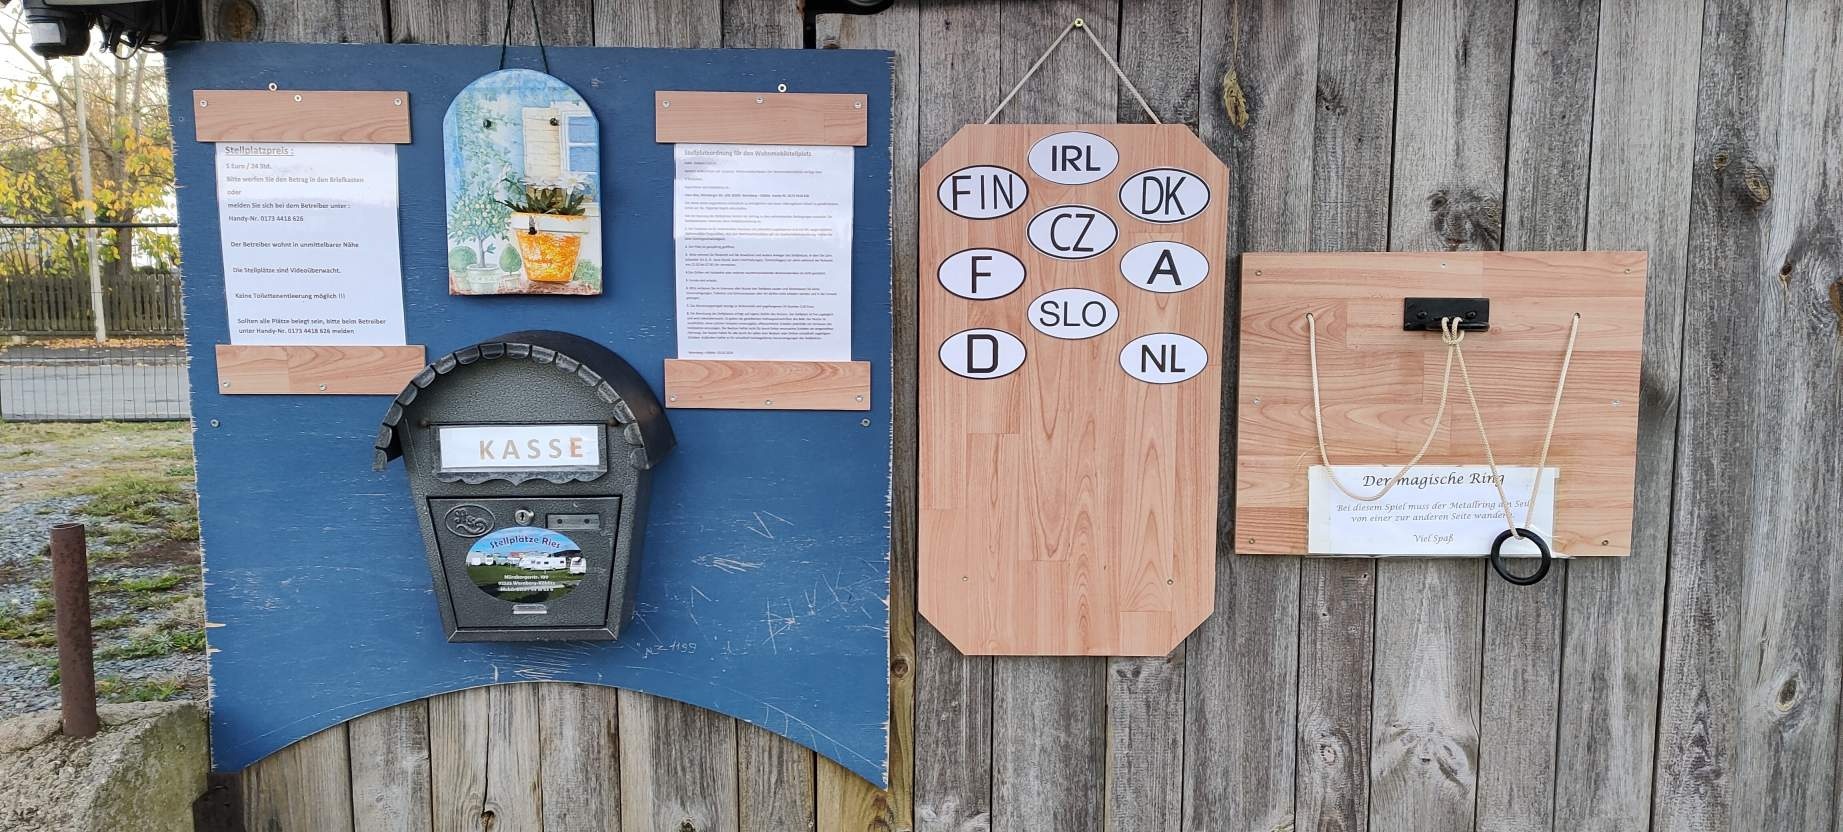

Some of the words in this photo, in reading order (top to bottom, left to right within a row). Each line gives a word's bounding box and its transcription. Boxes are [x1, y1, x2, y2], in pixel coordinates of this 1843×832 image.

[225, 146, 288, 156] Stellplatzpreis
[1051, 145, 1100, 172] IRL
[952, 174, 1014, 210] FIN
[1141, 176, 1186, 215] DK
[1050, 213, 1096, 252] CZ
[971, 256, 992, 294] F
[1146, 249, 1182, 286] A
[1039, 300, 1106, 328] SLO
[967, 334, 998, 374] D
[1141, 344, 1186, 373] NL
[479, 437, 584, 460] KASSE
[1362, 475, 1392, 487] Der
[1396, 472, 1464, 489] magische
[1384, 503, 1406, 513] Spiel
[1431, 502, 1447, 510] der
[1449, 501, 1496, 510] Metallring
[1413, 513, 1448, 521] anderen
[1451, 512, 1471, 520] Seite
[490, 536, 539, 549] Stellplätze
[541, 538, 560, 549] Ries
[1413, 534, 1431, 542] Viel
[1433, 533, 1454, 544] Spaß
